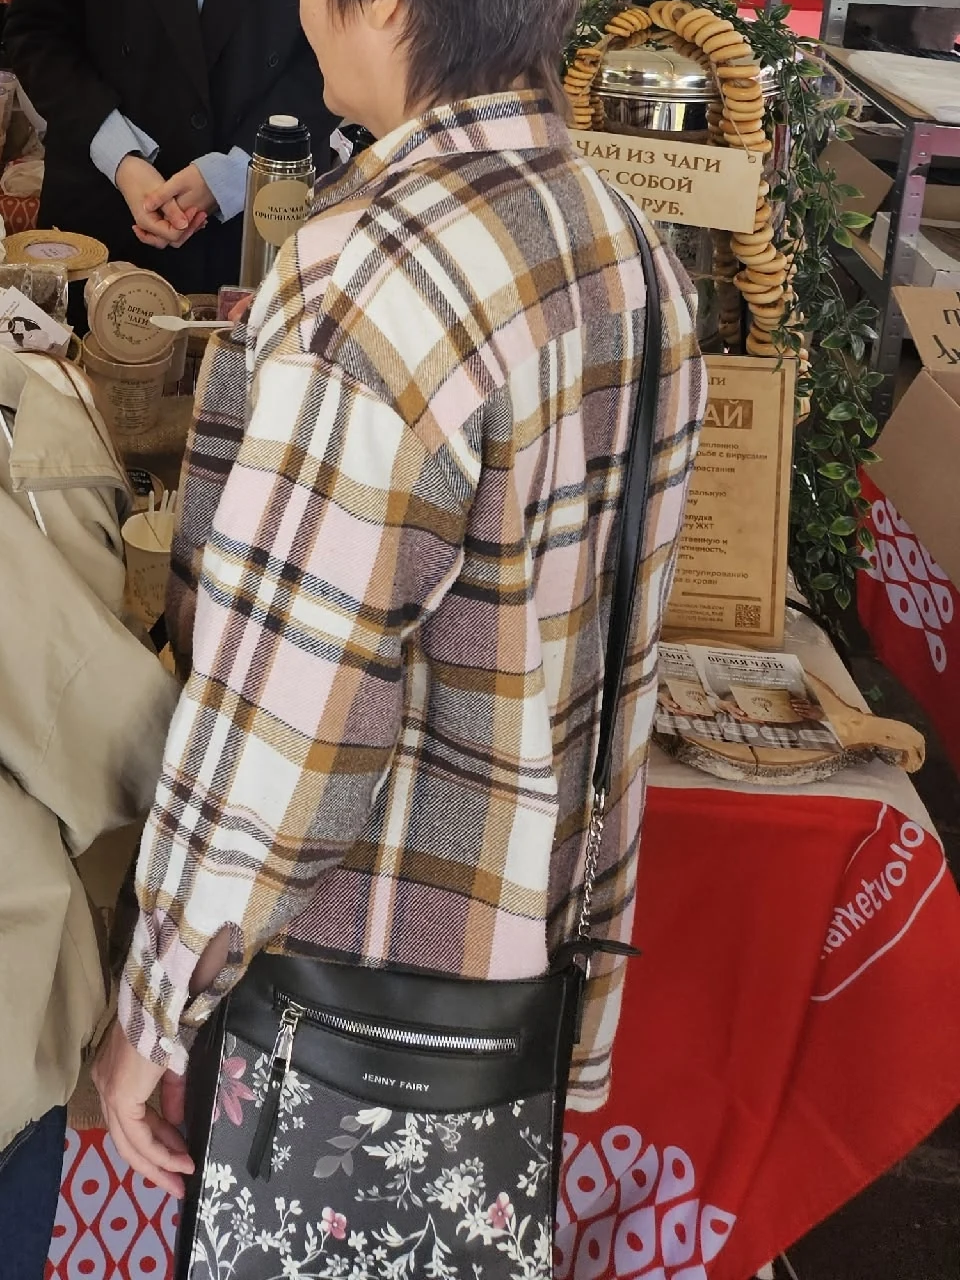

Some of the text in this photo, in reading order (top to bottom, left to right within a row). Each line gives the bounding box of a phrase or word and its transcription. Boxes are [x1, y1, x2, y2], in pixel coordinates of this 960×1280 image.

[576, 140, 722, 173] ЧАЙ ИЗ ЧАГИ
[615, 171, 694, 194] СОБОЙ
[255, 210, 308, 221] ОРИГИНАЛЬН
[641, 197, 685, 216] РУБ.
[127, 305, 154, 317] ВРЕМЯ
[703, 399, 744, 427] АЙ
[820, 821, 925, 960] arketvolo
[362, 1072, 430, 1092] JENNY FAIRY
